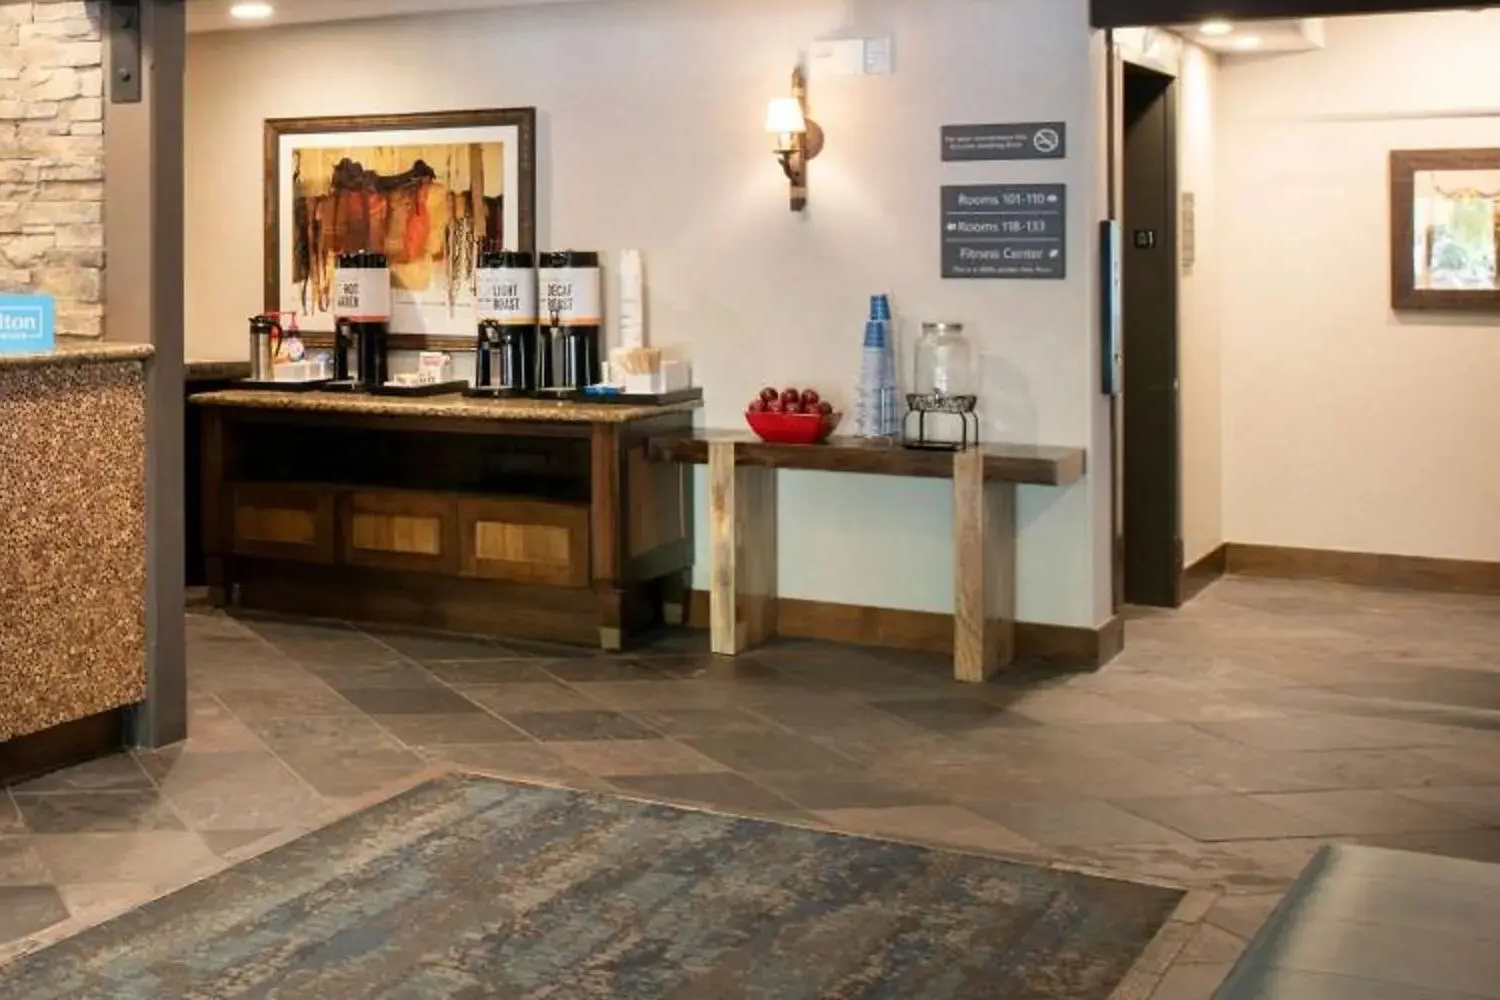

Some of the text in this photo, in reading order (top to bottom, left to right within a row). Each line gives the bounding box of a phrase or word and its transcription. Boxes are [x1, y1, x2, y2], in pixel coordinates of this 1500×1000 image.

[958, 194, 1000, 206] Rooms
[958, 221, 1000, 232] Rooms
[959, 247, 1044, 260] Fitness Center
[493, 283, 517, 297] LIGHT
[547, 283, 573, 297] DECAF
[493, 297, 519, 311] ROAST
